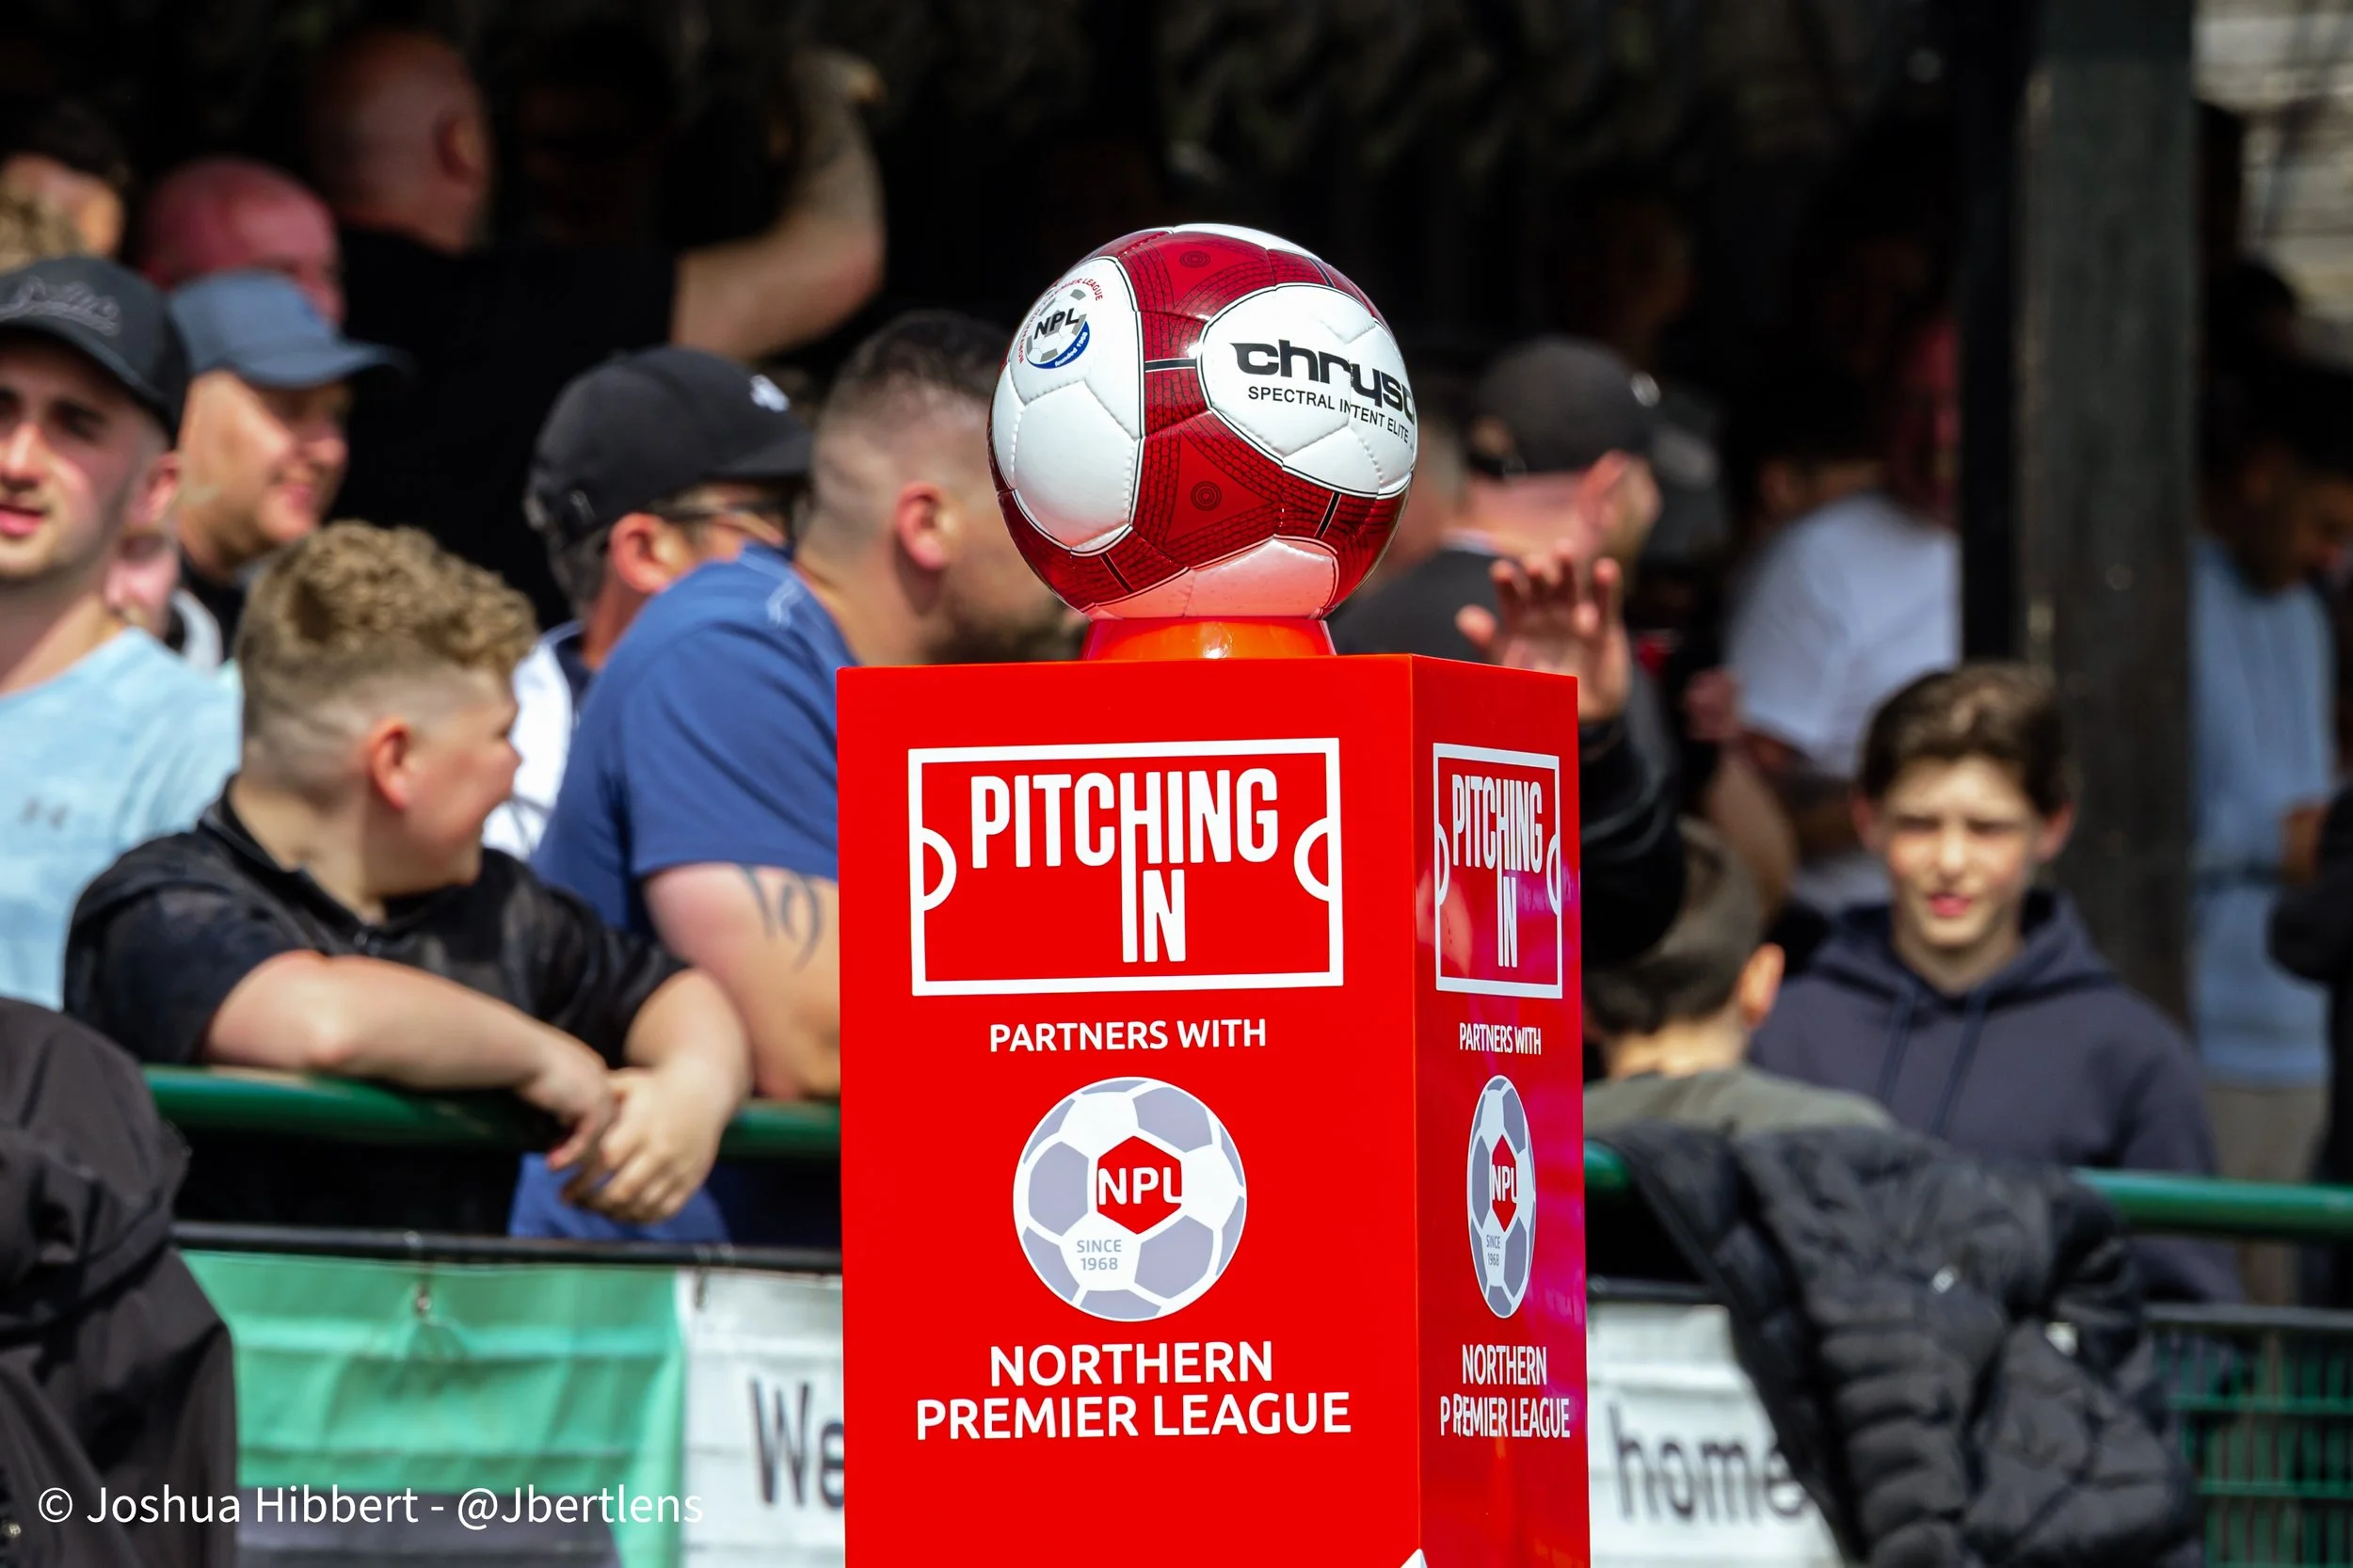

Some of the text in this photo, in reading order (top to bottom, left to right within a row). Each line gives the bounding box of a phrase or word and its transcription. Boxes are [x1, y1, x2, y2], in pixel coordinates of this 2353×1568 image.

[1081, 277, 1104, 302] LEAGUE
[1033, 307, 1080, 340] NPL
[1054, 346, 1078, 367] founded
[1247, 386, 1410, 444] SPECTRAL INTENT ELITE
[970, 768, 1279, 870] PITCHING
[1451, 774, 1543, 873] PITCHING
[1121, 868, 1187, 963] IN
[1497, 874, 1518, 968] IN
[989, 1018, 1267, 1052] PARTNERS WITH
[1459, 1022, 1542, 1055] PARTNERS WITH
[1096, 1165, 1183, 1207] NPL
[1491, 1163, 1519, 1204] NPL
[1076, 1239, 1123, 1254] SINCE
[1486, 1234, 1501, 1250] SINCE
[1487, 1253, 1500, 1267] 1968
[1080, 1256, 1119, 1271] 1968
[990, 1340, 1273, 1387] NORTHERN
[1462, 1344, 1547, 1386] NORTHERN
[917, 1391, 1353, 1440] PREMIER LEAGUE
[1440, 1393, 1571, 1439] PREMIER LEAGUE
